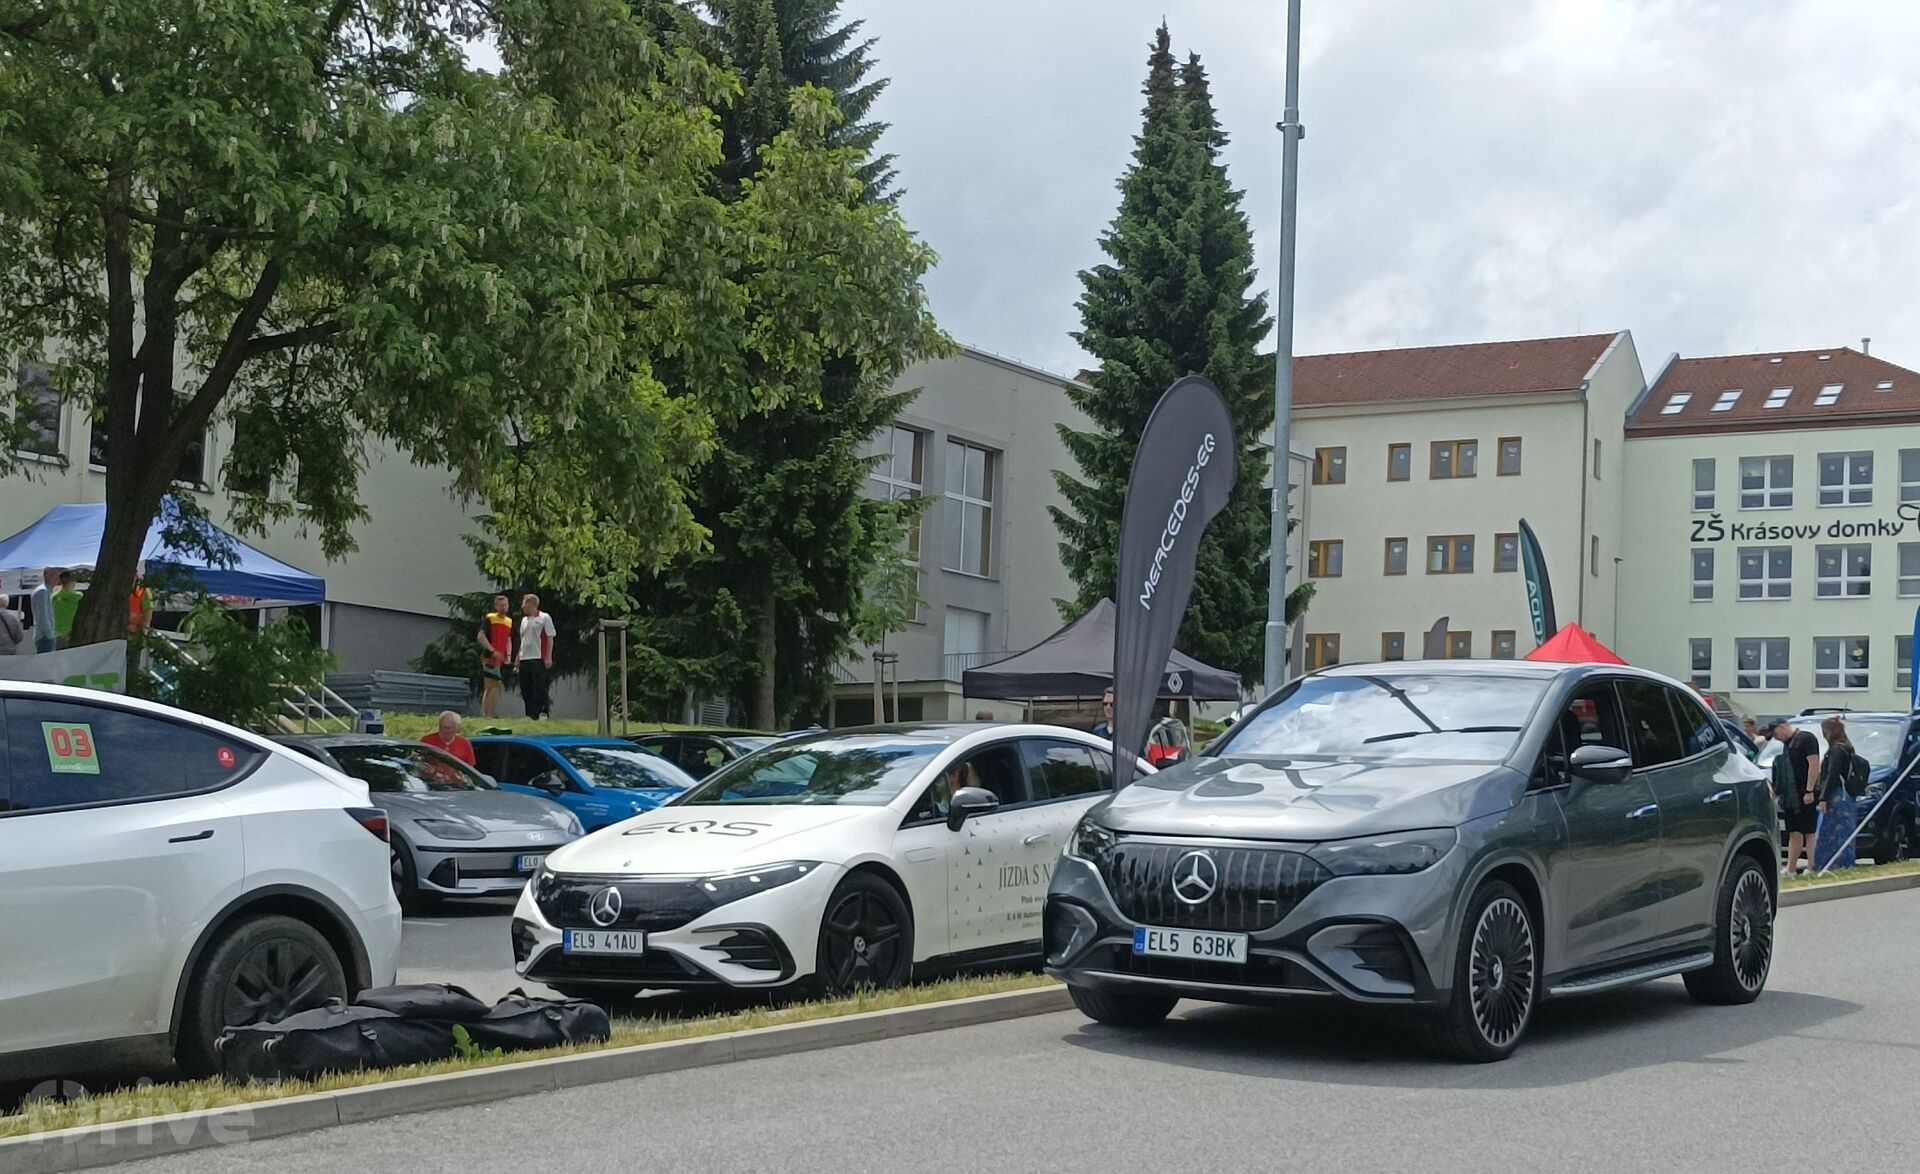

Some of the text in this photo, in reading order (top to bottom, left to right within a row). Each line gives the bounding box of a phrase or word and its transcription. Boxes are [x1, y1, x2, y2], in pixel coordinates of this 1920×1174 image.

[1140, 433, 1215, 610] MERCEDES-EQ
[1690, 513, 1904, 542] ZŠ Krásovy domky
[51, 728, 92, 757] 03
[621, 820, 773, 837] EQS
[998, 862, 1030, 890] JÍZDA
[1033, 864, 1039, 885] S
[573, 933, 637, 951] EL9 41AU
[1148, 931, 1237, 958] EL5 63BK
